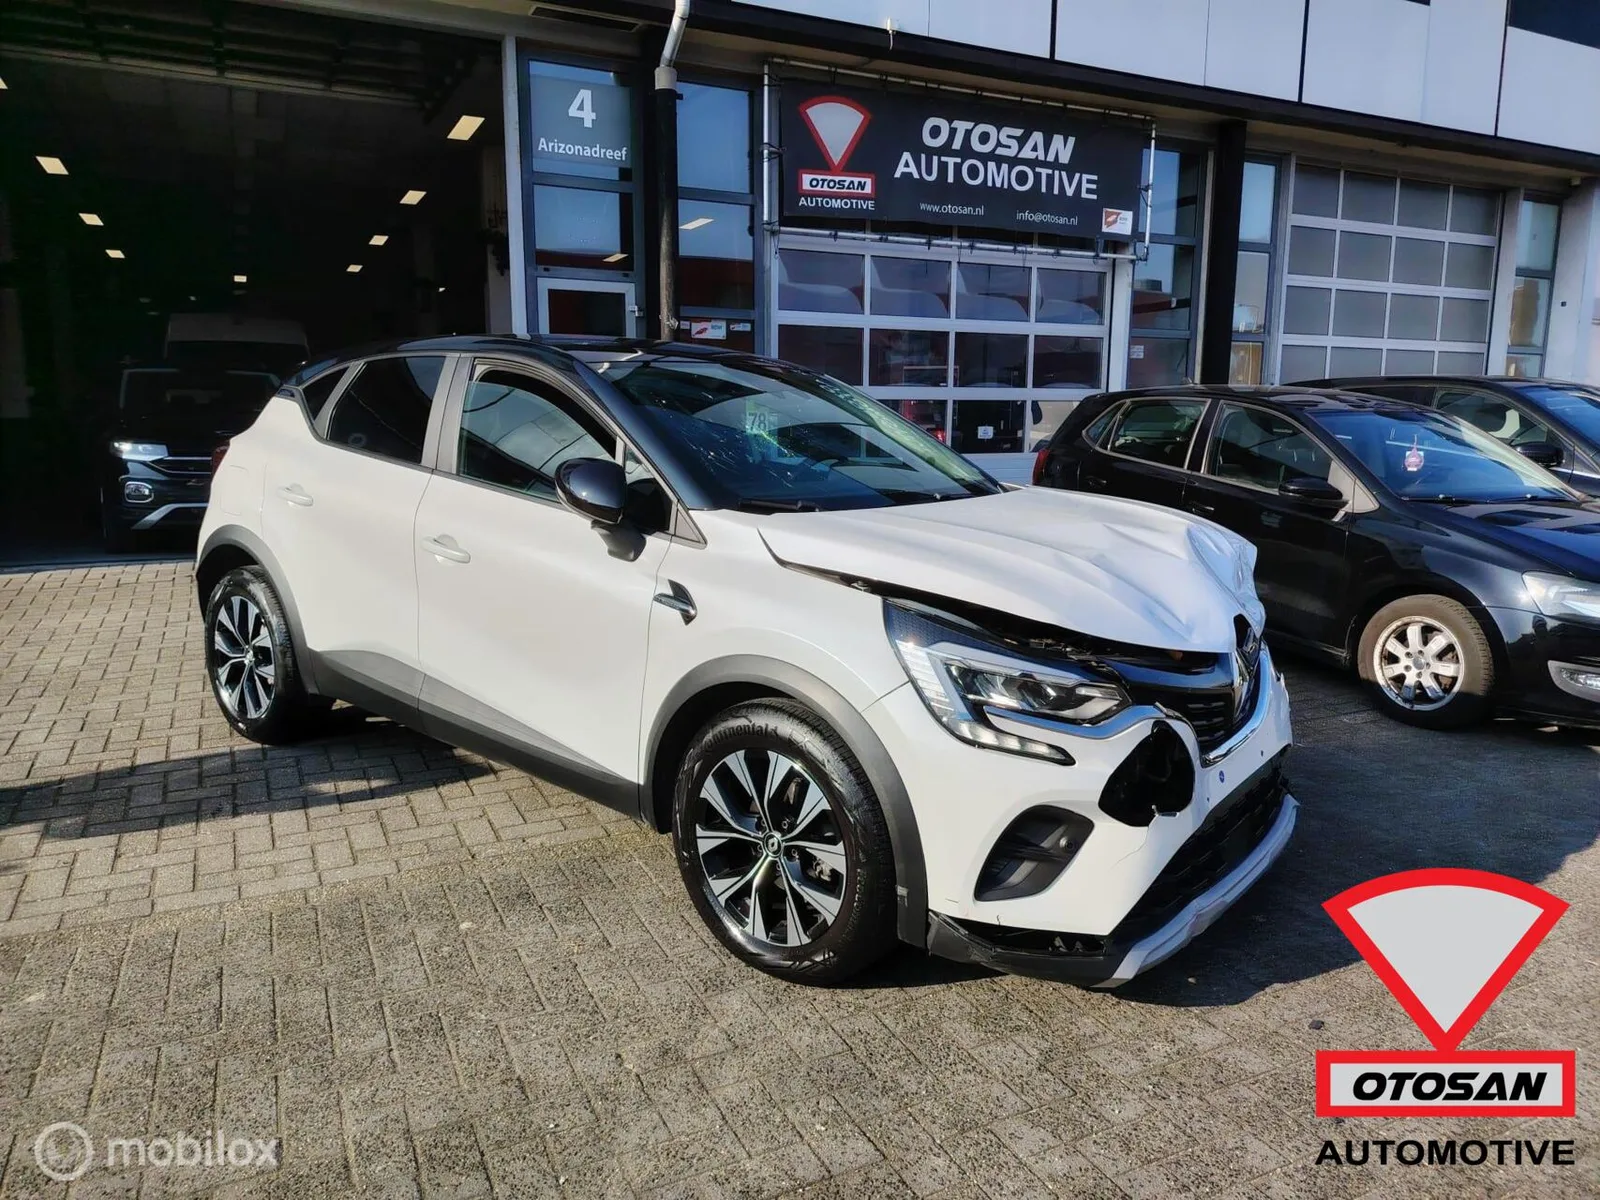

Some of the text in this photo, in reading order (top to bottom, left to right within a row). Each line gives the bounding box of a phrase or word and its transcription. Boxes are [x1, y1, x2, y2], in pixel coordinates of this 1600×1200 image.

[568, 88, 597, 128] 4
[537, 137, 628, 161] Arizonadreef
[922, 116, 1076, 165] OTOSAN
[809, 177, 867, 191] OTOSAN
[893, 151, 1099, 200] AUTOMOTIVE
[798, 196, 876, 211] AUTOMOTIVE
[919, 201, 985, 216] www.otosan.nl
[1016, 210, 1078, 226] info@otosan.nl
[748, 412, 768, 433] 78
